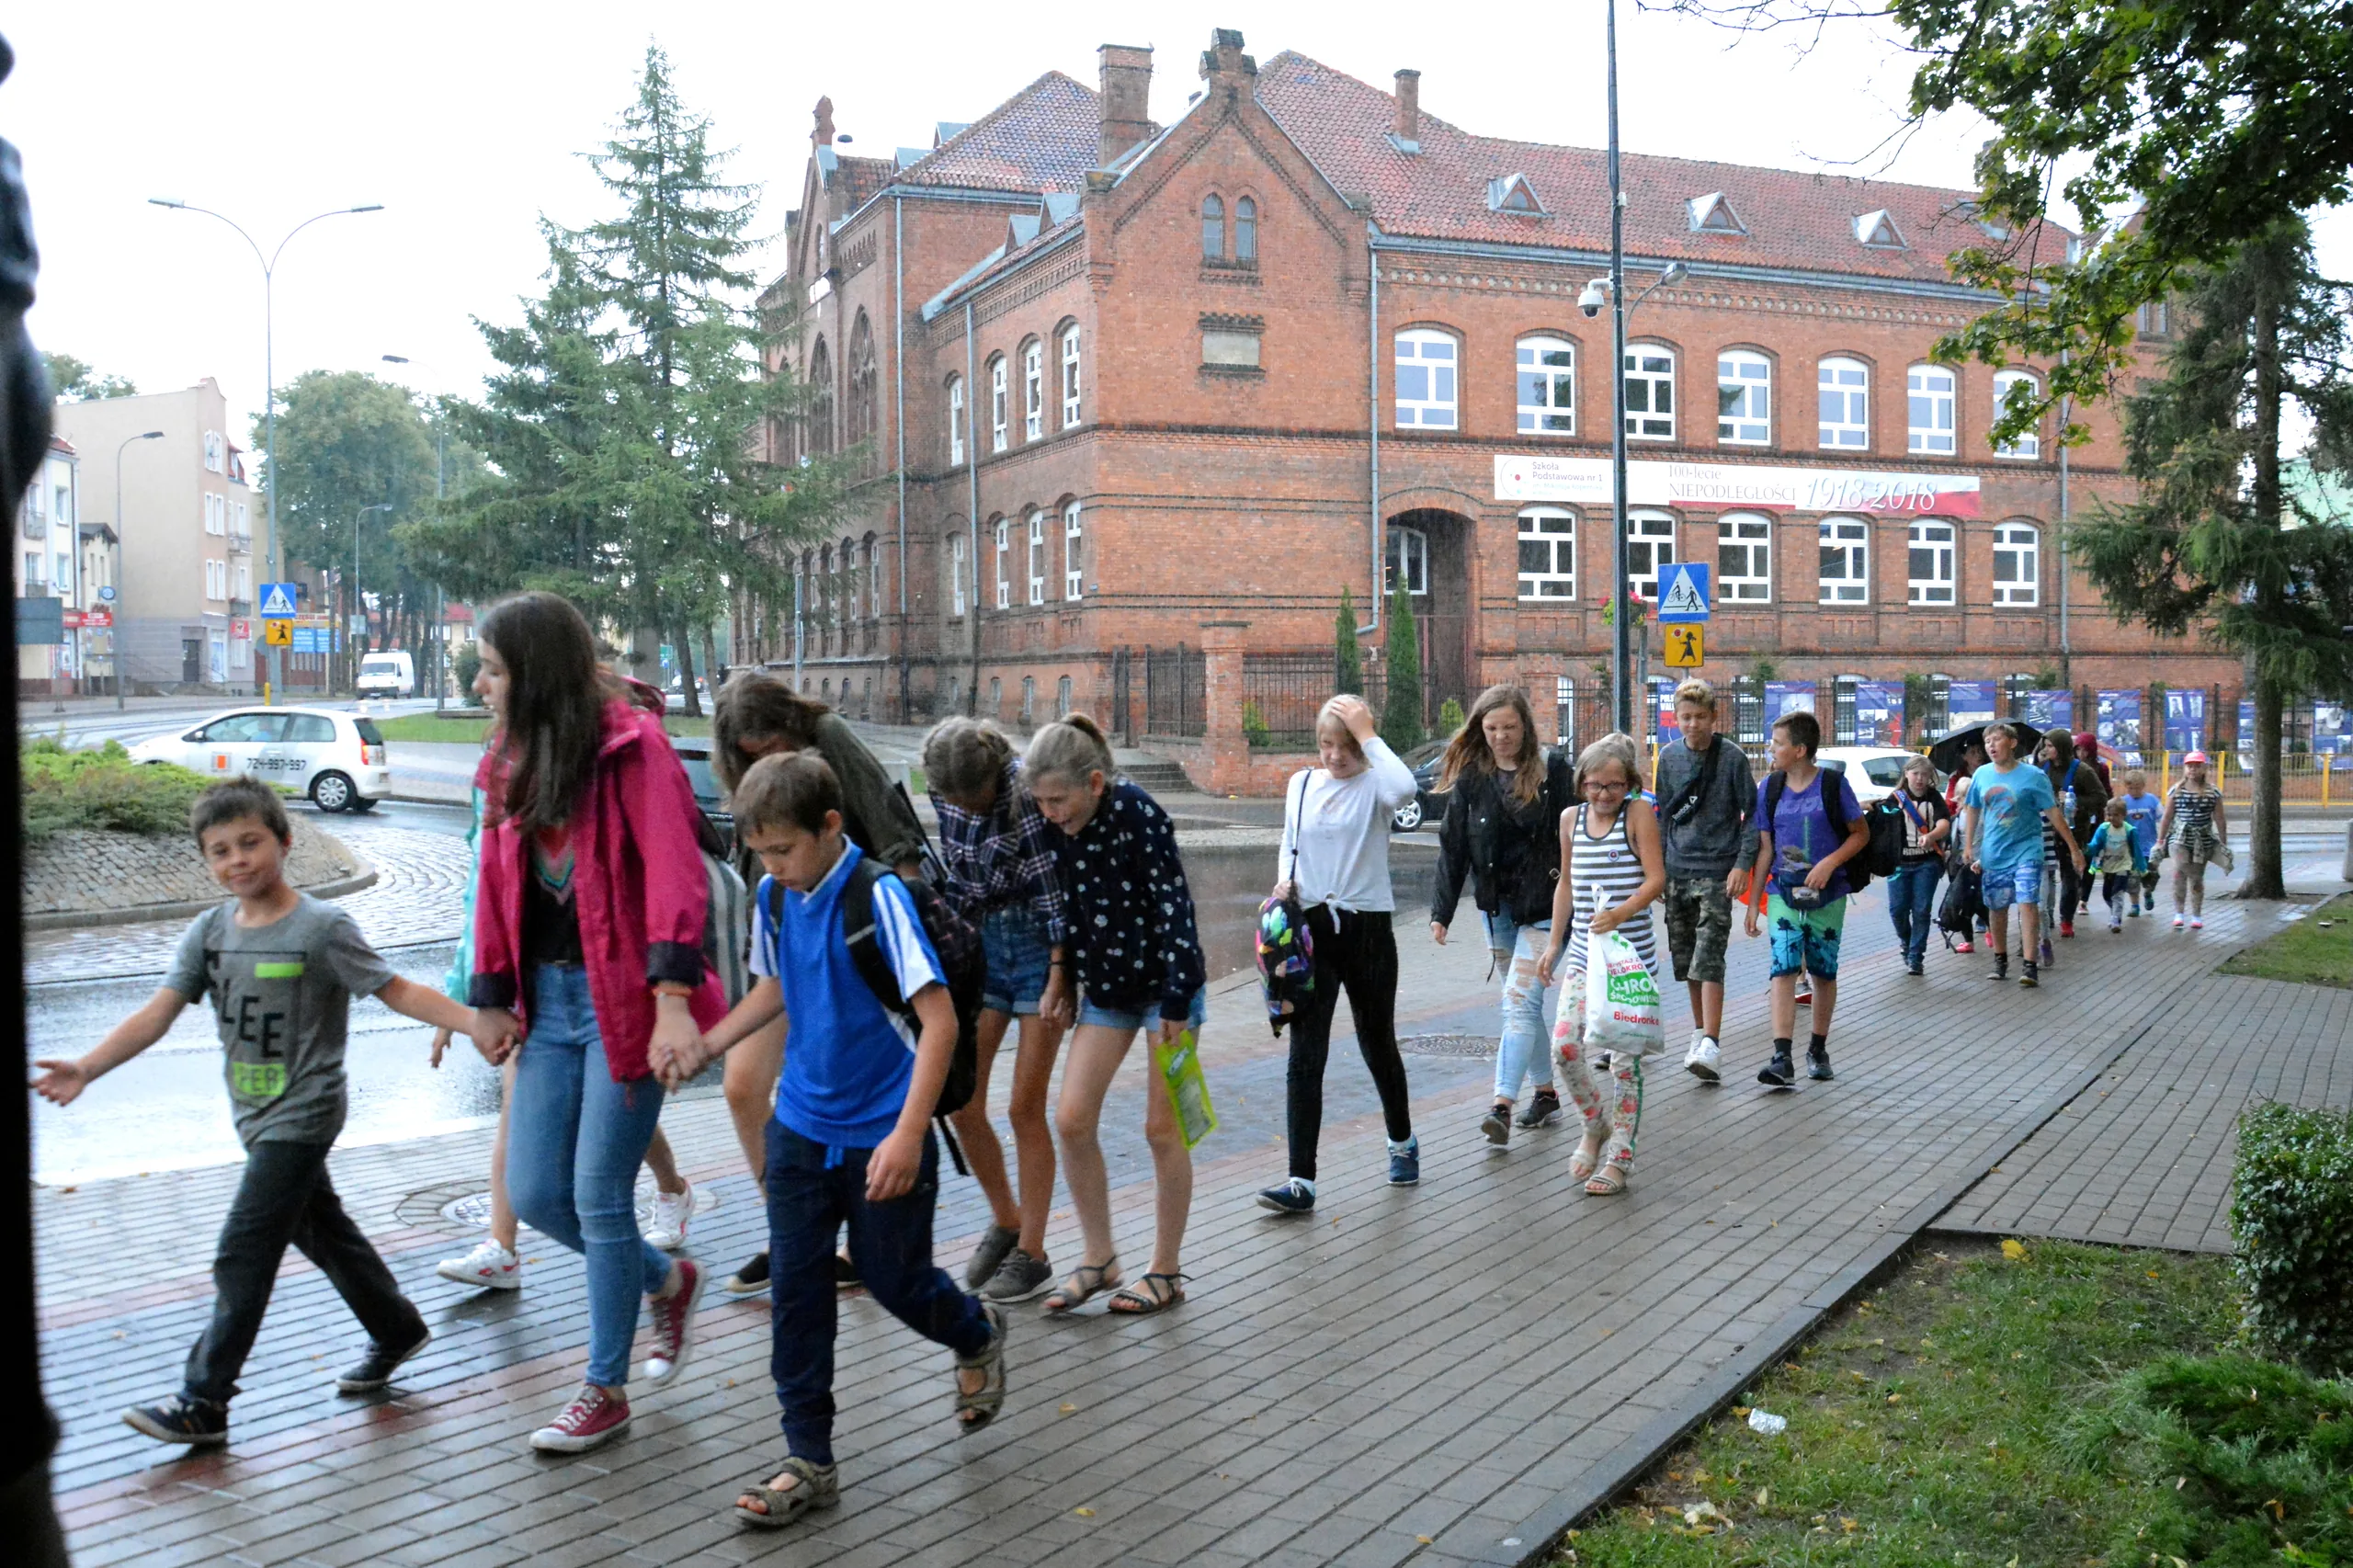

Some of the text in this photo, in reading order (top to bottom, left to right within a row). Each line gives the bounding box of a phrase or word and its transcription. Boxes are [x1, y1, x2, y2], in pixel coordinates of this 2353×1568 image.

[1532, 461, 1560, 471] Szkoła
[1668, 465, 1722, 480] 100-lecie
[1532, 472, 1585, 482] Podstawowa
[1668, 482, 1796, 501] NIEPODLEGŁOŚCI
[1807, 477, 1940, 511] 1918-2018
[246, 757, 307, 771] 724-997-997
